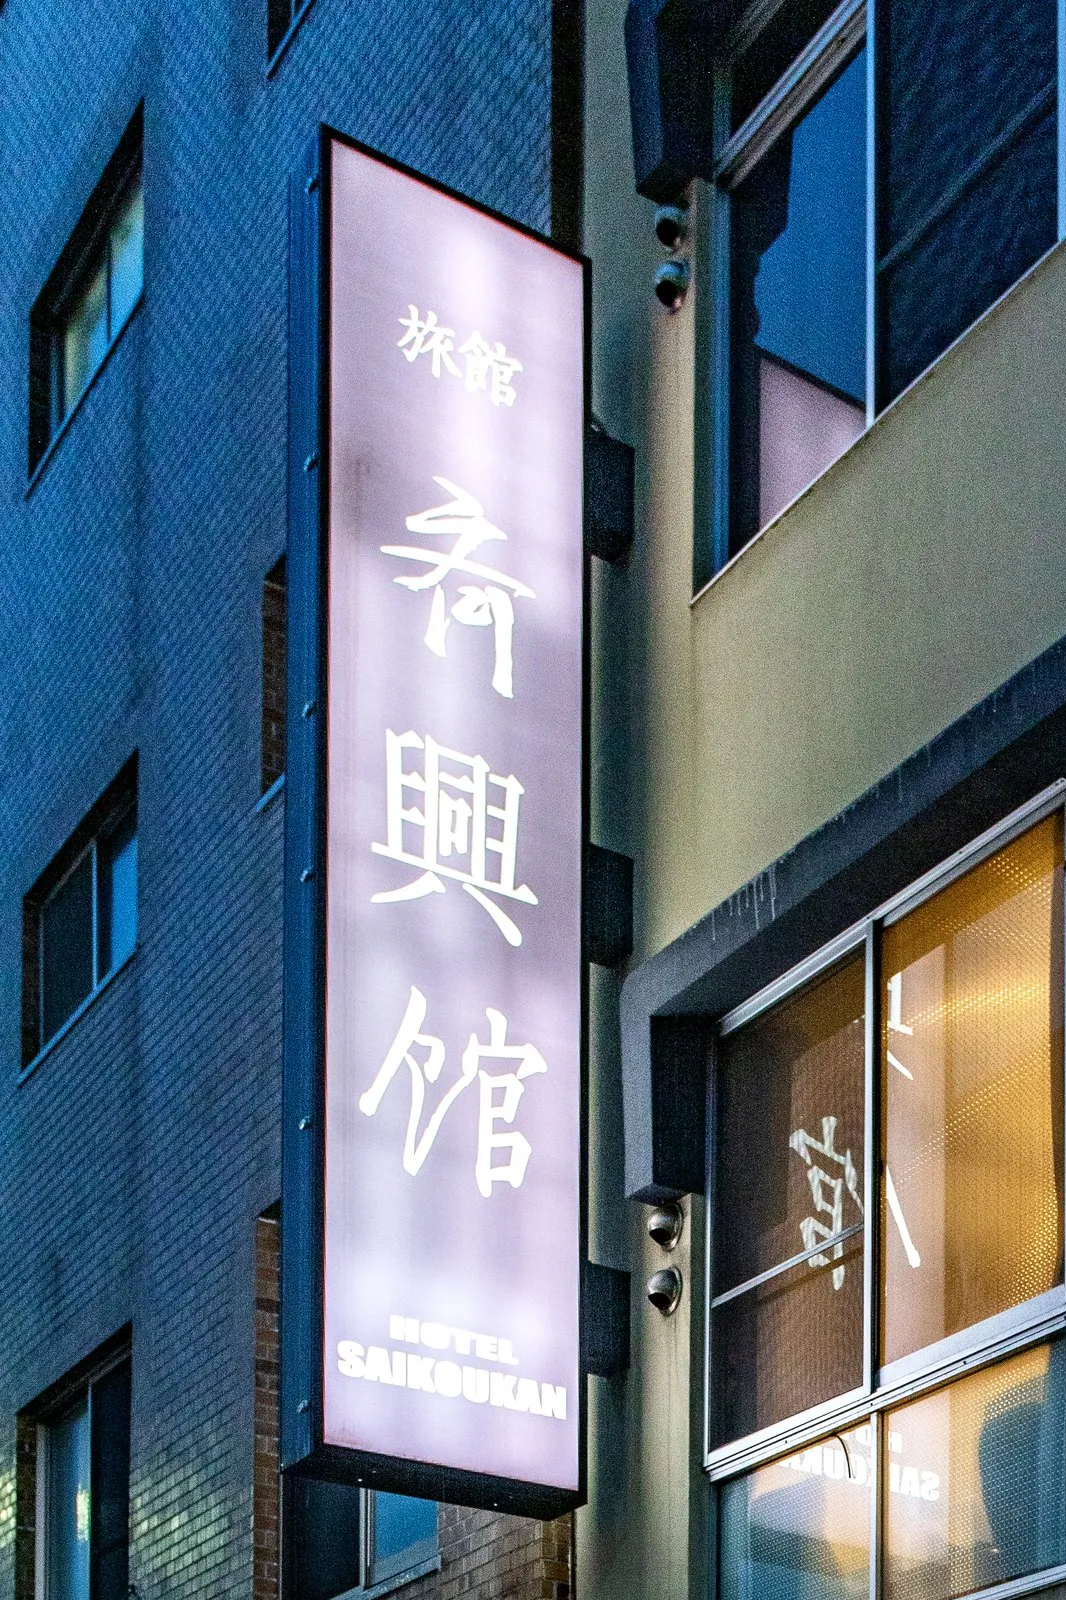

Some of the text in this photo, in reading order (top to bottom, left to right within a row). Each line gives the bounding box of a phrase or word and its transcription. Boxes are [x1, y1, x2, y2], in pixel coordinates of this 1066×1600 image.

[398, 304, 523, 407] 旅館
[389, 1313, 519, 1366] HOTEL
[337, 1341, 567, 1421] SAIKOUKAN
